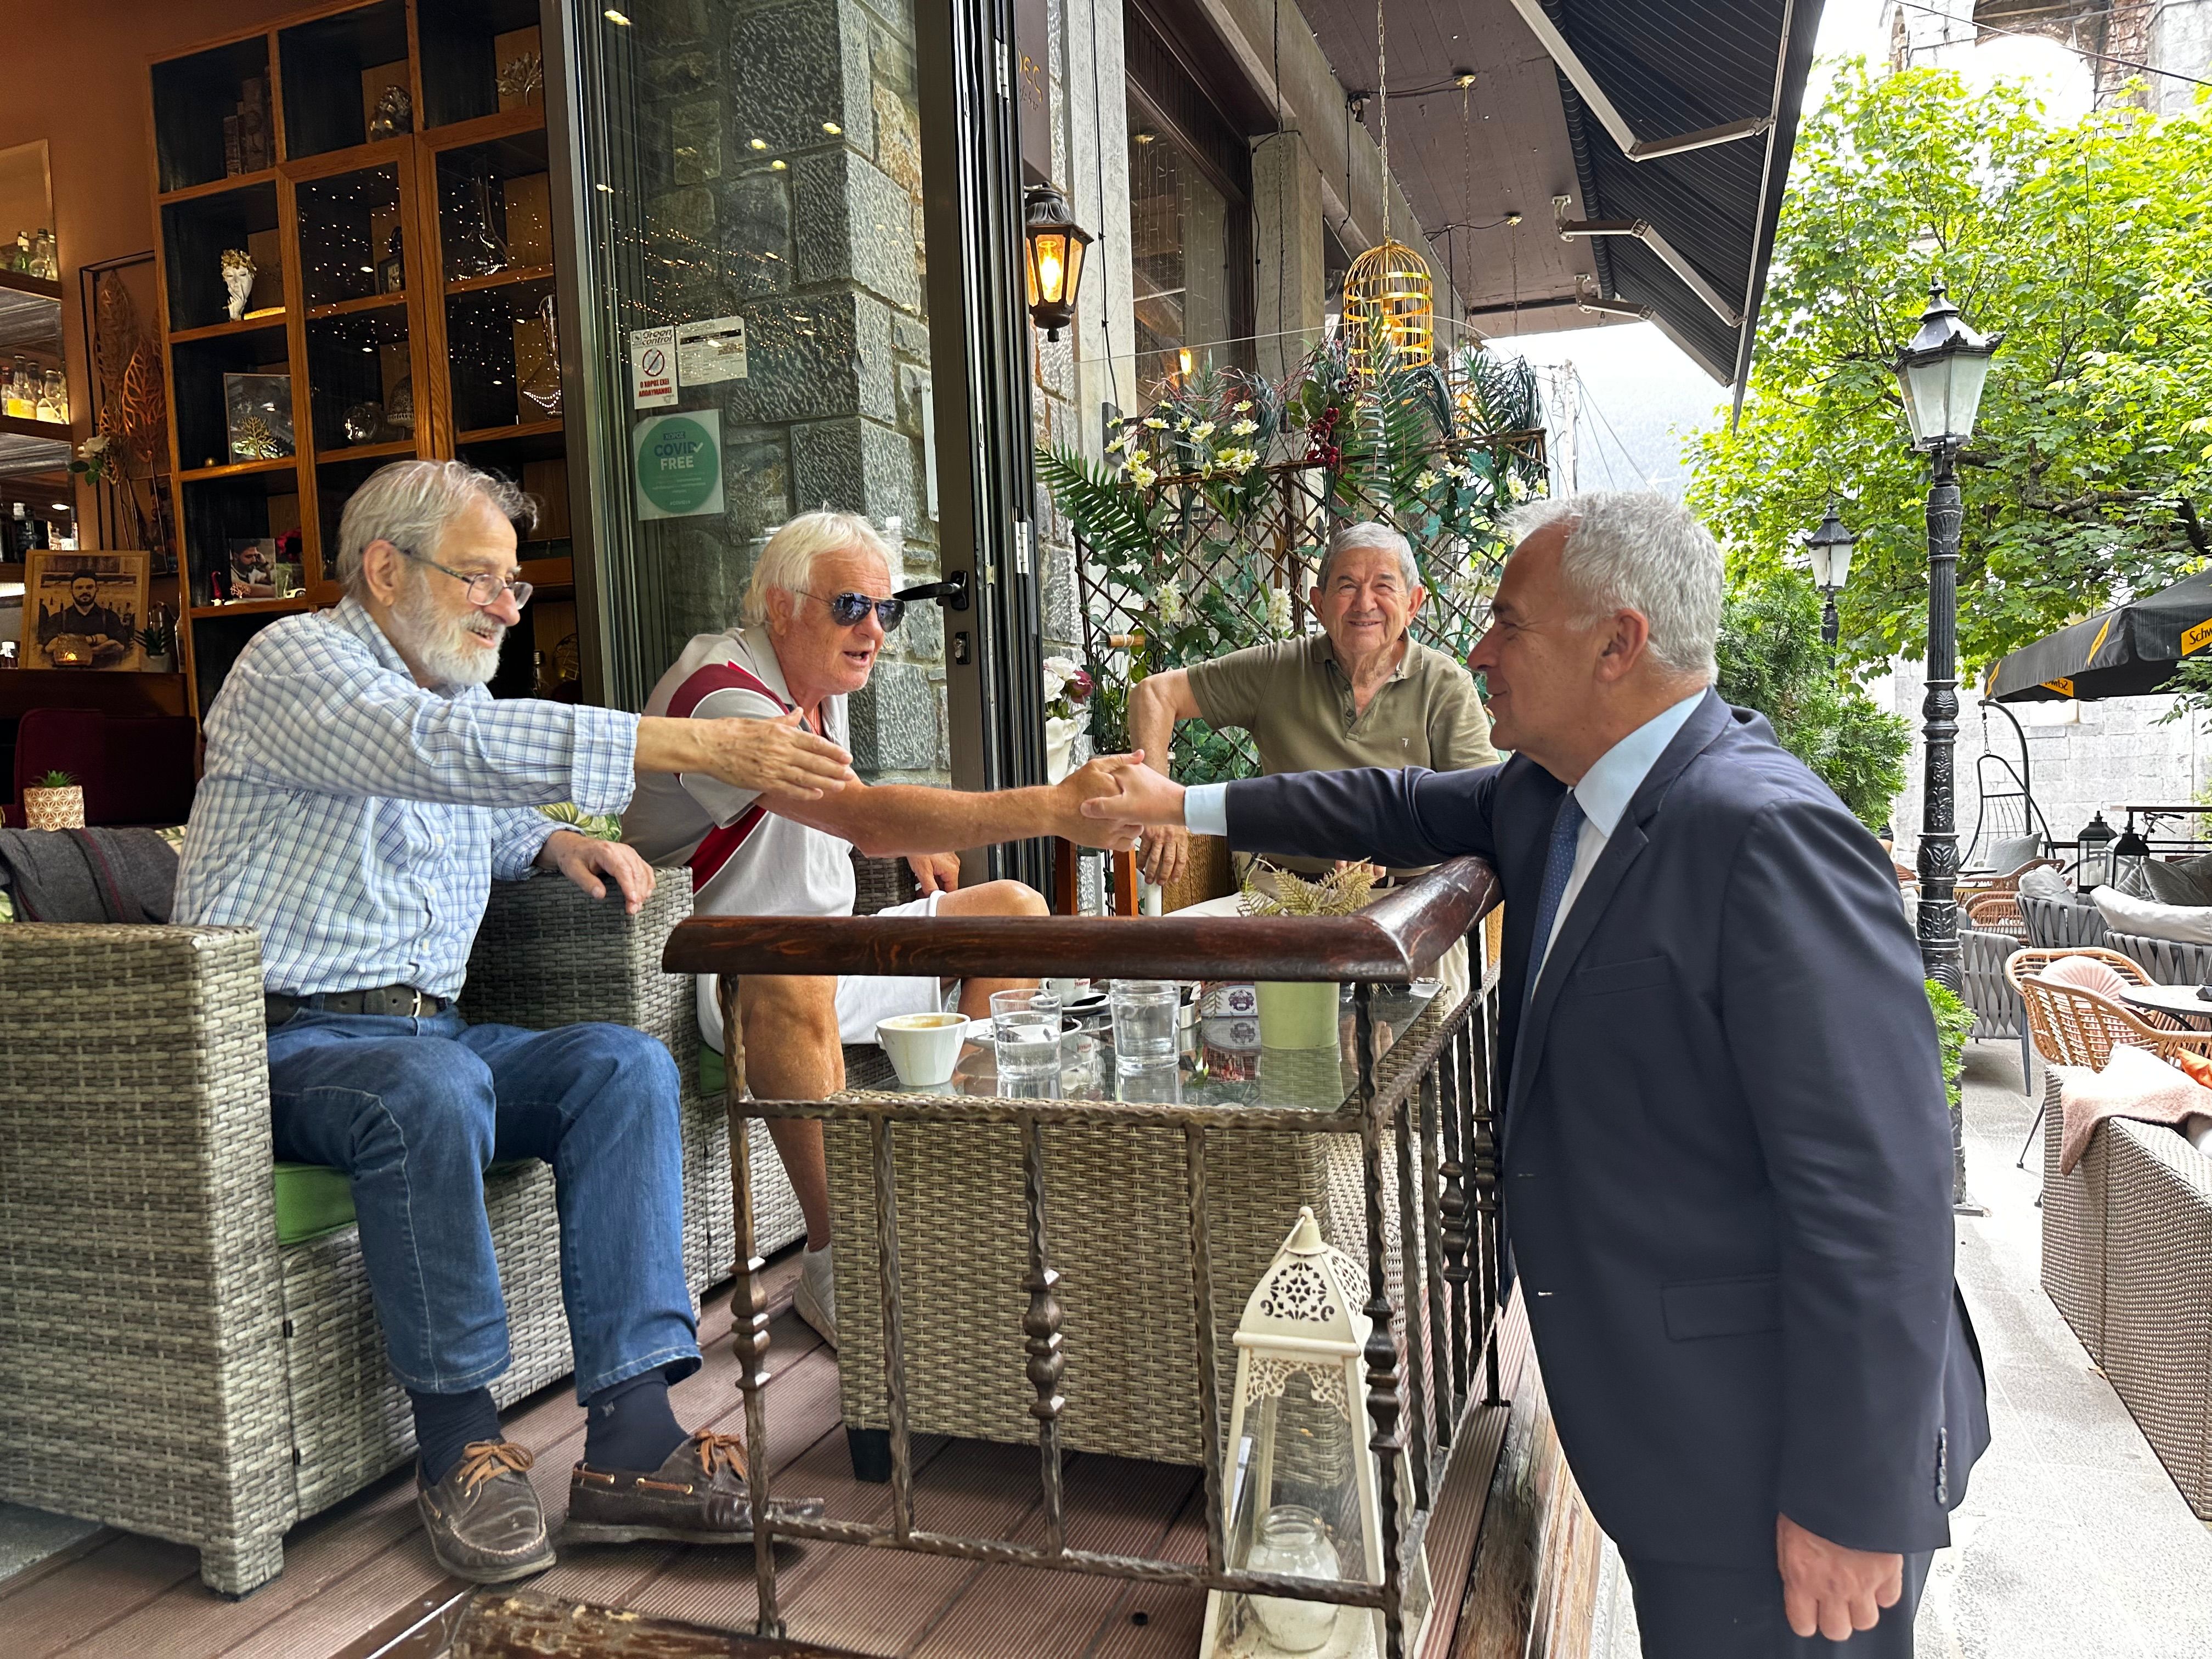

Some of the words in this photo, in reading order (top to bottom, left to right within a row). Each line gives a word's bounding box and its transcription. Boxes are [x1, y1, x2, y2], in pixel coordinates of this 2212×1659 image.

[642, 335, 672, 346] control
[654, 442, 697, 457] COVID
[661, 455, 694, 471] FREE
